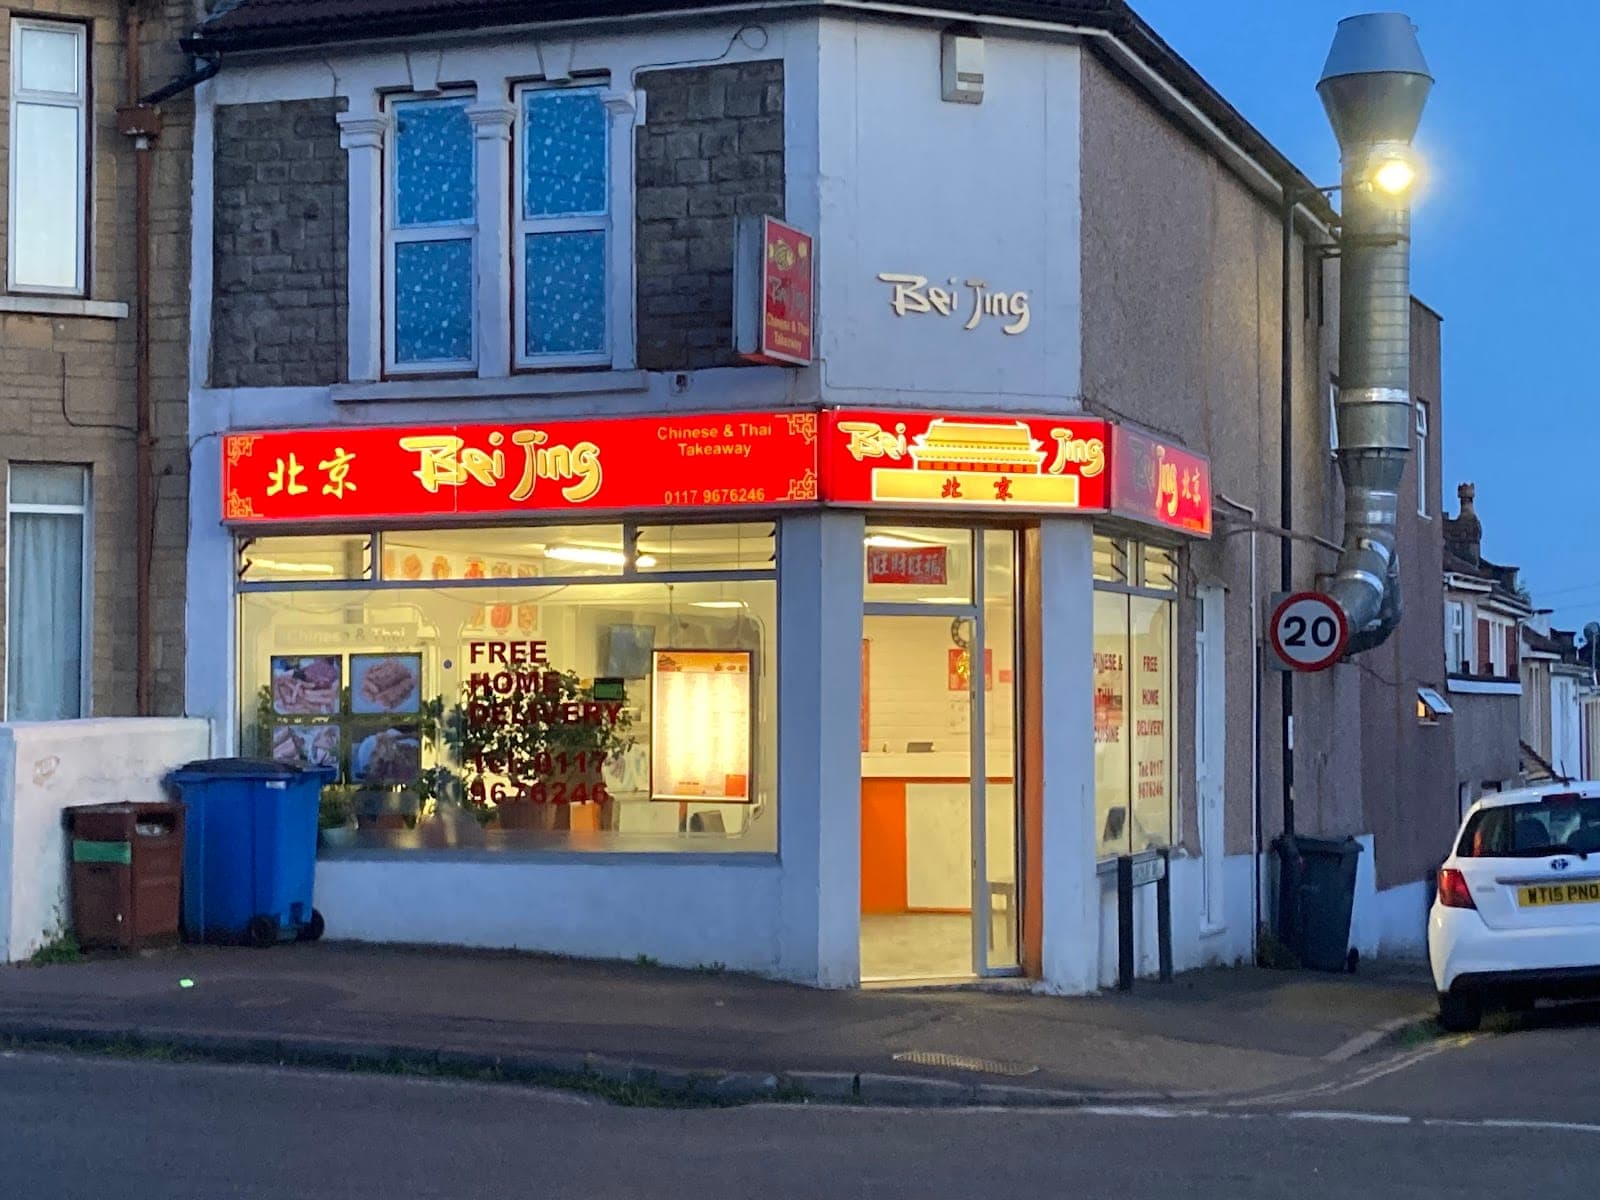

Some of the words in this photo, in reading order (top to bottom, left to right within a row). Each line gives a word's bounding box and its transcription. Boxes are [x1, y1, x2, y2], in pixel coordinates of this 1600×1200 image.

[879, 273, 958, 317] Bei
[965, 279, 1031, 335] Jing
[657, 426, 719, 440] Chinese
[723, 424, 734, 437] &
[739, 423, 772, 436] Thai
[678, 443, 752, 458] Takeaway
[837, 421, 907, 461] Bei
[1049, 428, 1105, 477] Jing
[267, 447, 357, 500] 北京
[399, 431, 505, 493] Bei
[509, 430, 602, 502] Jing
[664, 490, 698, 504] 0117
[703, 488, 765, 503] 9676246
[1284, 616, 1337, 647] 20
[470, 641, 548, 664] FREE
[1143, 656, 1158, 672] FREE
[470, 672, 560, 697] HOME
[1142, 689, 1159, 706] HOME
[469, 702, 623, 728] DELIVERY
[1137, 720, 1164, 737] DELIVERY
[534, 750, 607, 774] 0117
